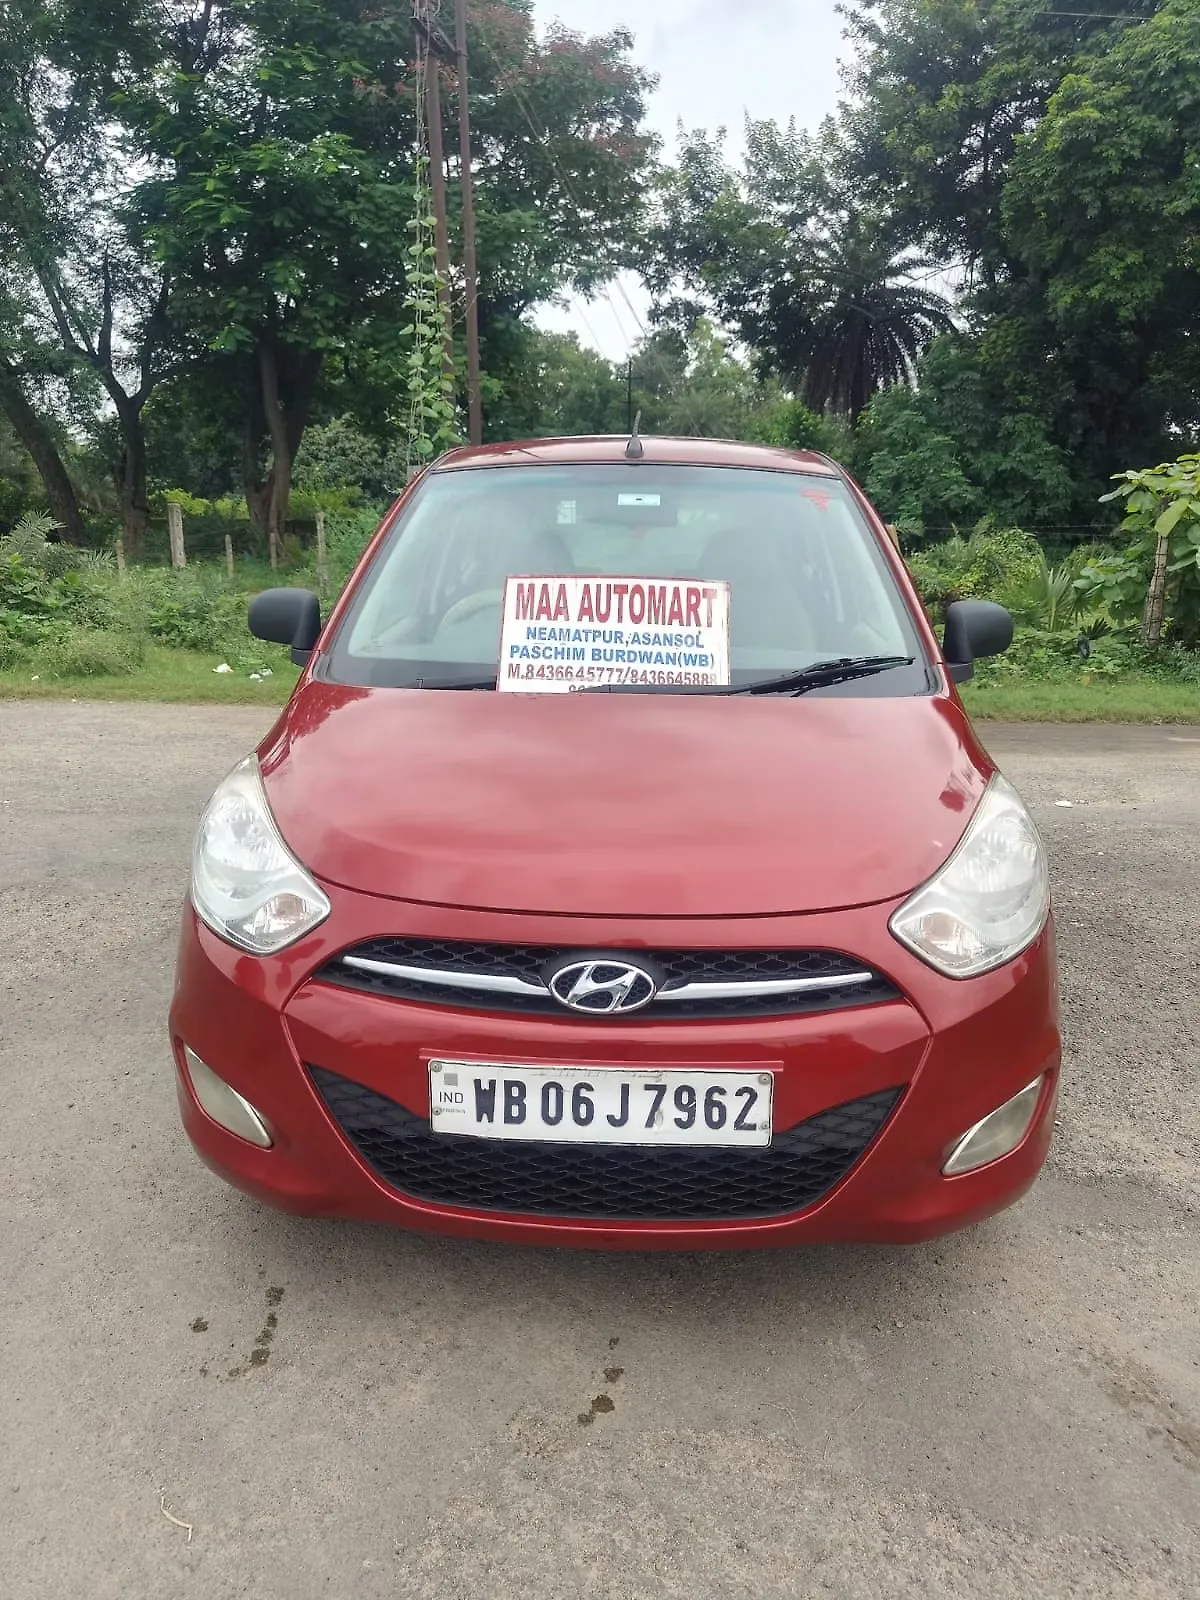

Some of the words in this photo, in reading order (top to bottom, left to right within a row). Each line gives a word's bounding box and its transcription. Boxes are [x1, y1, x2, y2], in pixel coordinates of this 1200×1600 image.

[515, 583, 569, 622] MAA
[577, 583, 718, 628] AUTOMART
[510, 644, 585, 661] PASCHIM
[591, 648, 715, 668] BURDWAN(WB)
[439, 1091, 464, 1104] IND
[473, 1078, 527, 1125] WB
[541, 1081, 595, 1127] 06
[606, 1083, 630, 1128] J
[643, 1084, 759, 1131] 7962
